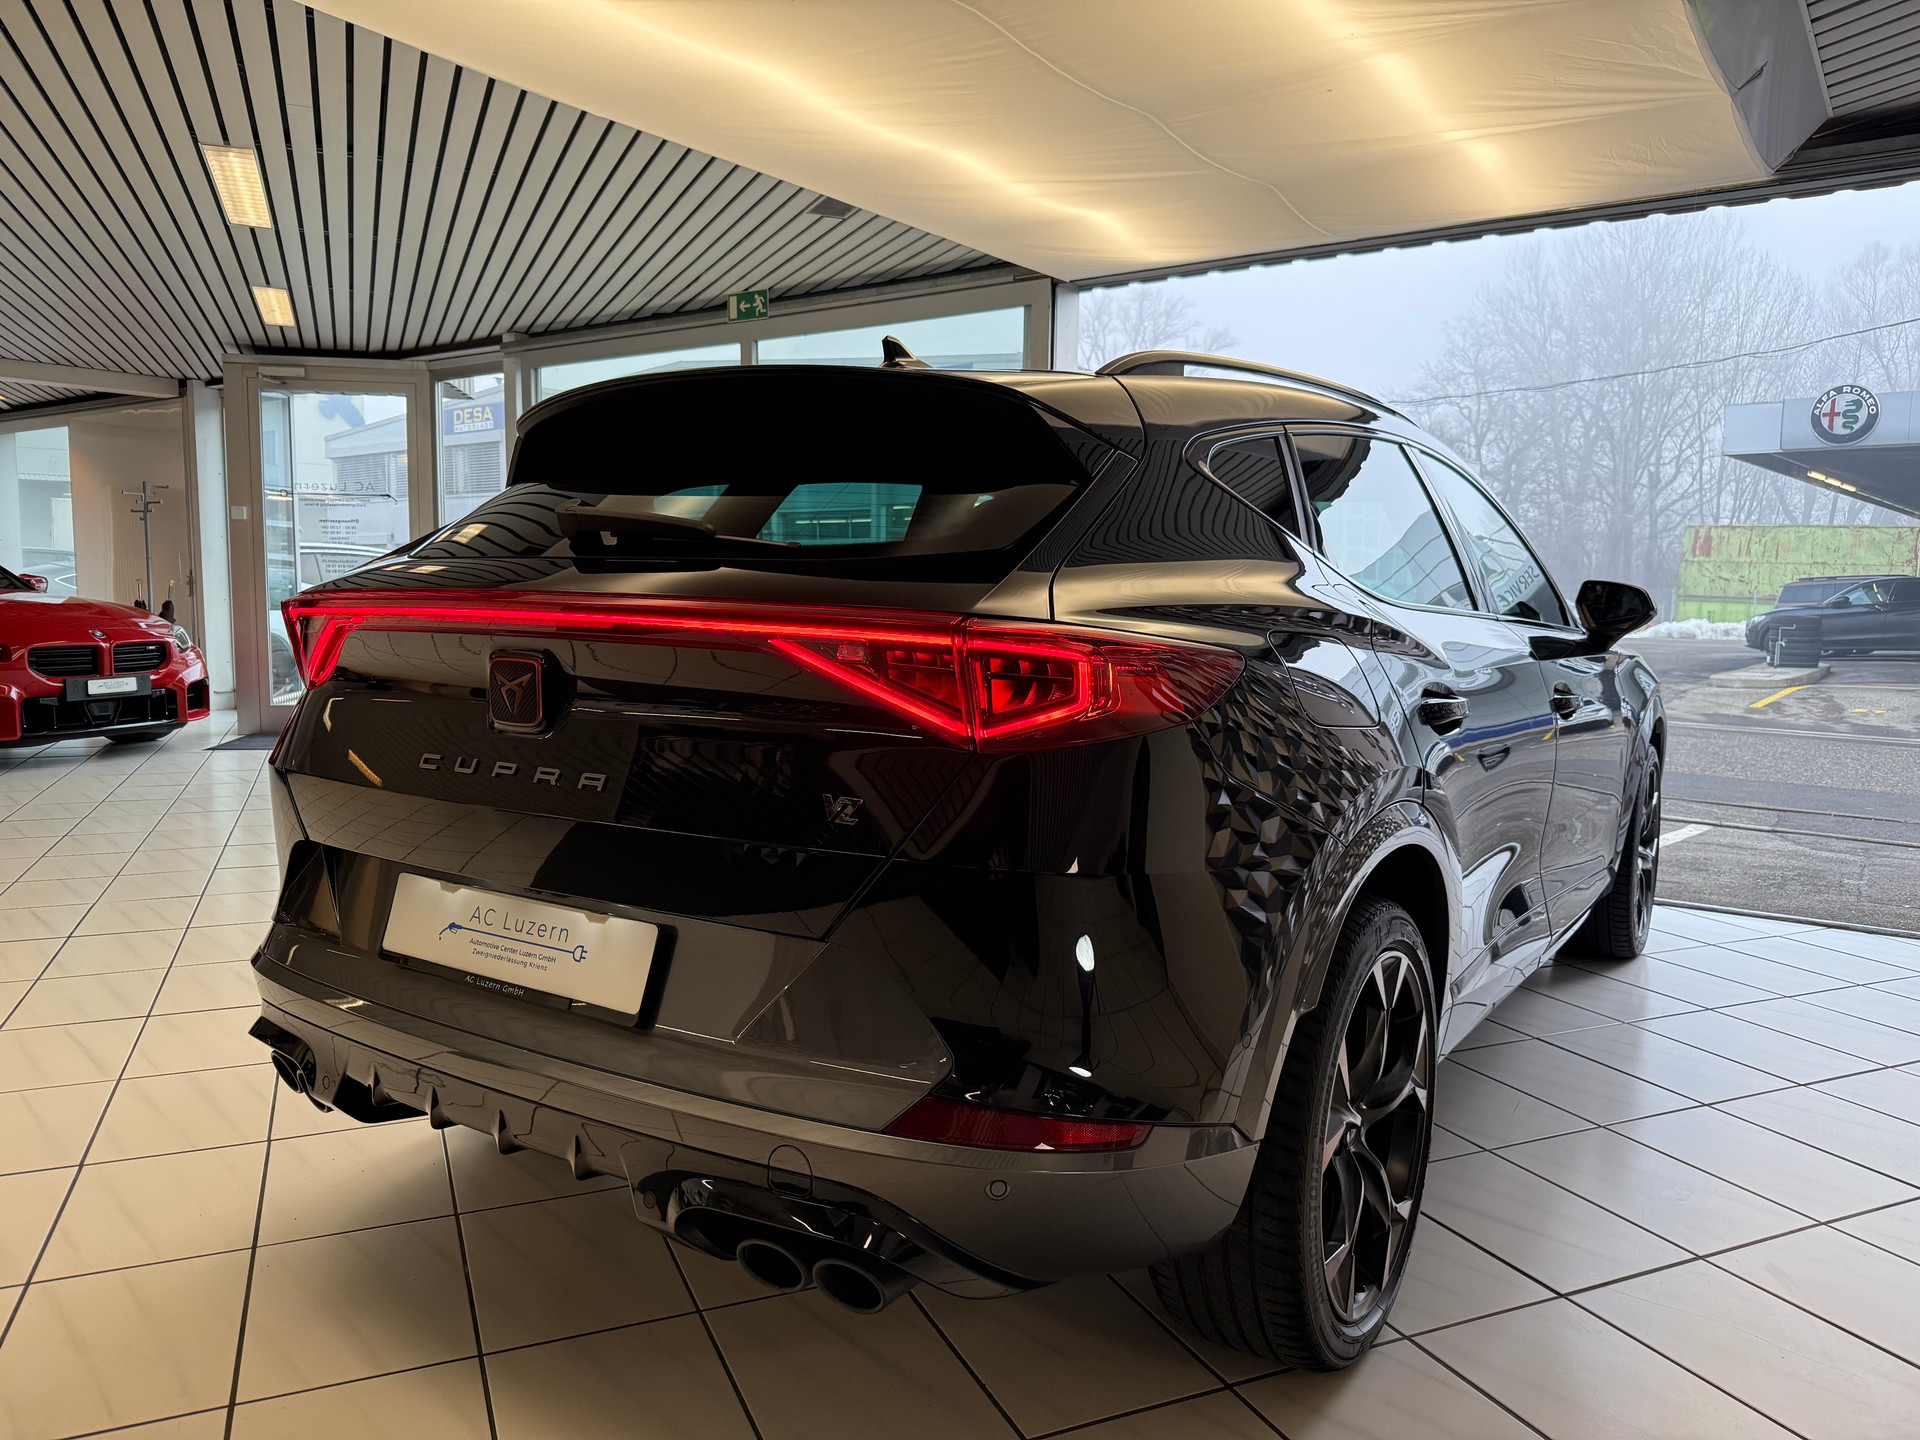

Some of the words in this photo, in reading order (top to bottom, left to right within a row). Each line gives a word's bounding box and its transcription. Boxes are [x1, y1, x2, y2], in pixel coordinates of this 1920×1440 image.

[1813, 390, 1837, 416] ALFA
[1842, 386, 1877, 415] ROMEO
[453, 406, 493, 425] DESA
[418, 752, 609, 792] CUPRA
[822, 793, 864, 826] VZ
[469, 905, 497, 927] AC
[502, 911, 570, 943] Luzern
[469, 938, 500, 951] Automotive
[500, 945, 519, 954] Center
[519, 949, 538, 959] Luzern
[538, 953, 557, 963] GmbH
[472, 947, 528, 968] Zweigniederlassung
[528, 962, 548, 972] Kriens
[464, 975, 475, 984] AC
[476, 978, 501, 991] Luzern
[502, 984, 525, 997] GmbH
